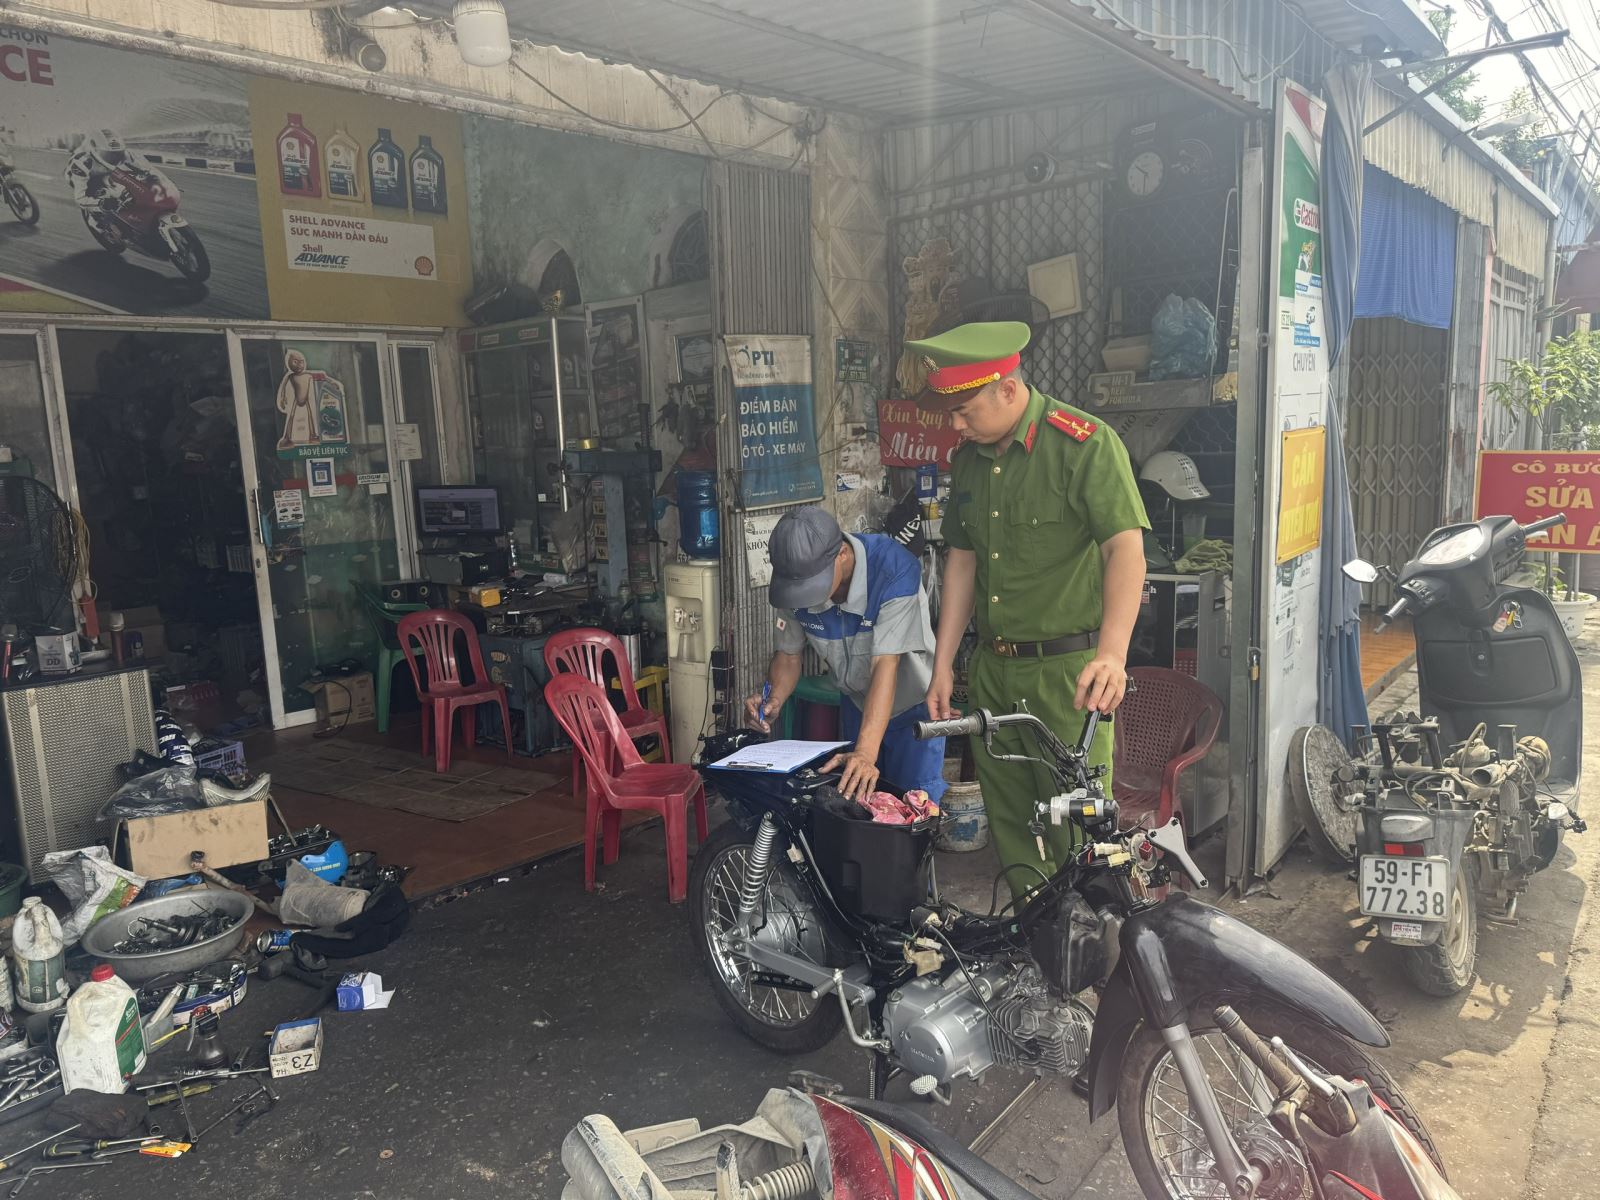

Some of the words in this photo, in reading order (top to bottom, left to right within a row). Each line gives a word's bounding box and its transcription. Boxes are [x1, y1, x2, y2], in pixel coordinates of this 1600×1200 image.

[289, 214, 318, 226] SHELL
[320, 218, 366, 230] ADVANCE
[302, 243, 323, 253] Shell
[294, 252, 350, 266] ADVANCE
[751, 350, 775, 366] PTI
[740, 396, 771, 415] ĐIỂM
[769, 416, 799, 435] HIỂM
[751, 443, 765, 457] TÔ
[772, 444, 786, 455] XE
[788, 442, 806, 454] MÁY
[1511, 460, 1546, 474] CÔ
[1524, 478, 1595, 510] SỬA
[47, 658, 60, 666] DD
[1374, 860, 1433, 887] 59-F1
[1366, 886, 1444, 916] 772.38
[291, 1053, 314, 1070] Z3
